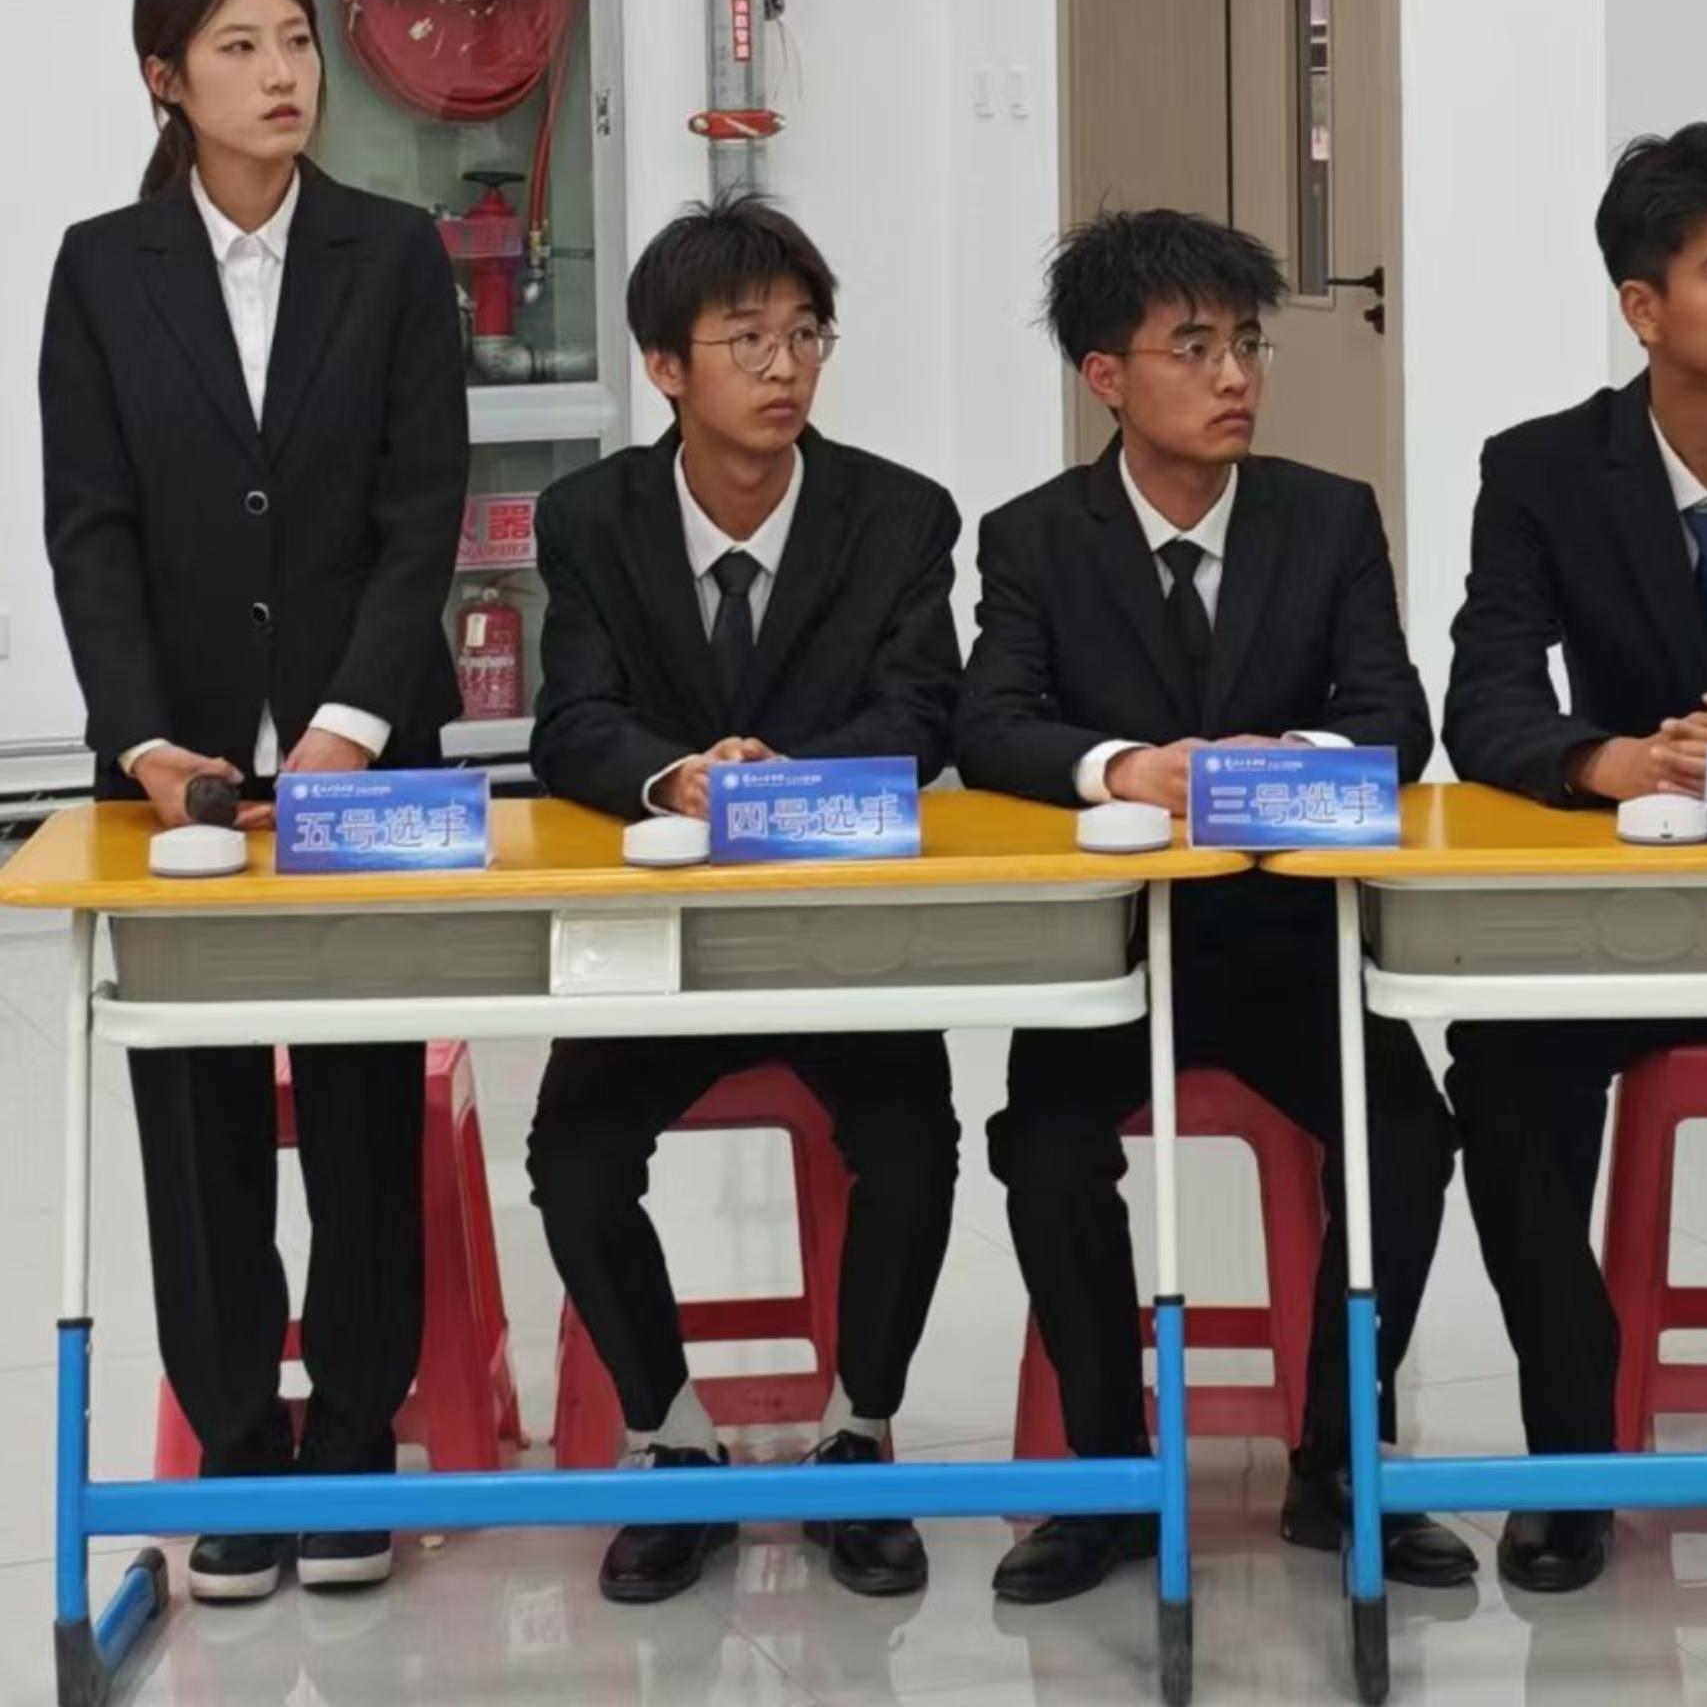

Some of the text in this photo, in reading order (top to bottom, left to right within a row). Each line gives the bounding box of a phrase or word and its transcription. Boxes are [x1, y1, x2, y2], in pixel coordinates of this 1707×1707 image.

[291, 800, 470, 852] 五号选手
[727, 787, 903, 842] 四号选手
[1208, 776, 1384, 827] 三号选手
